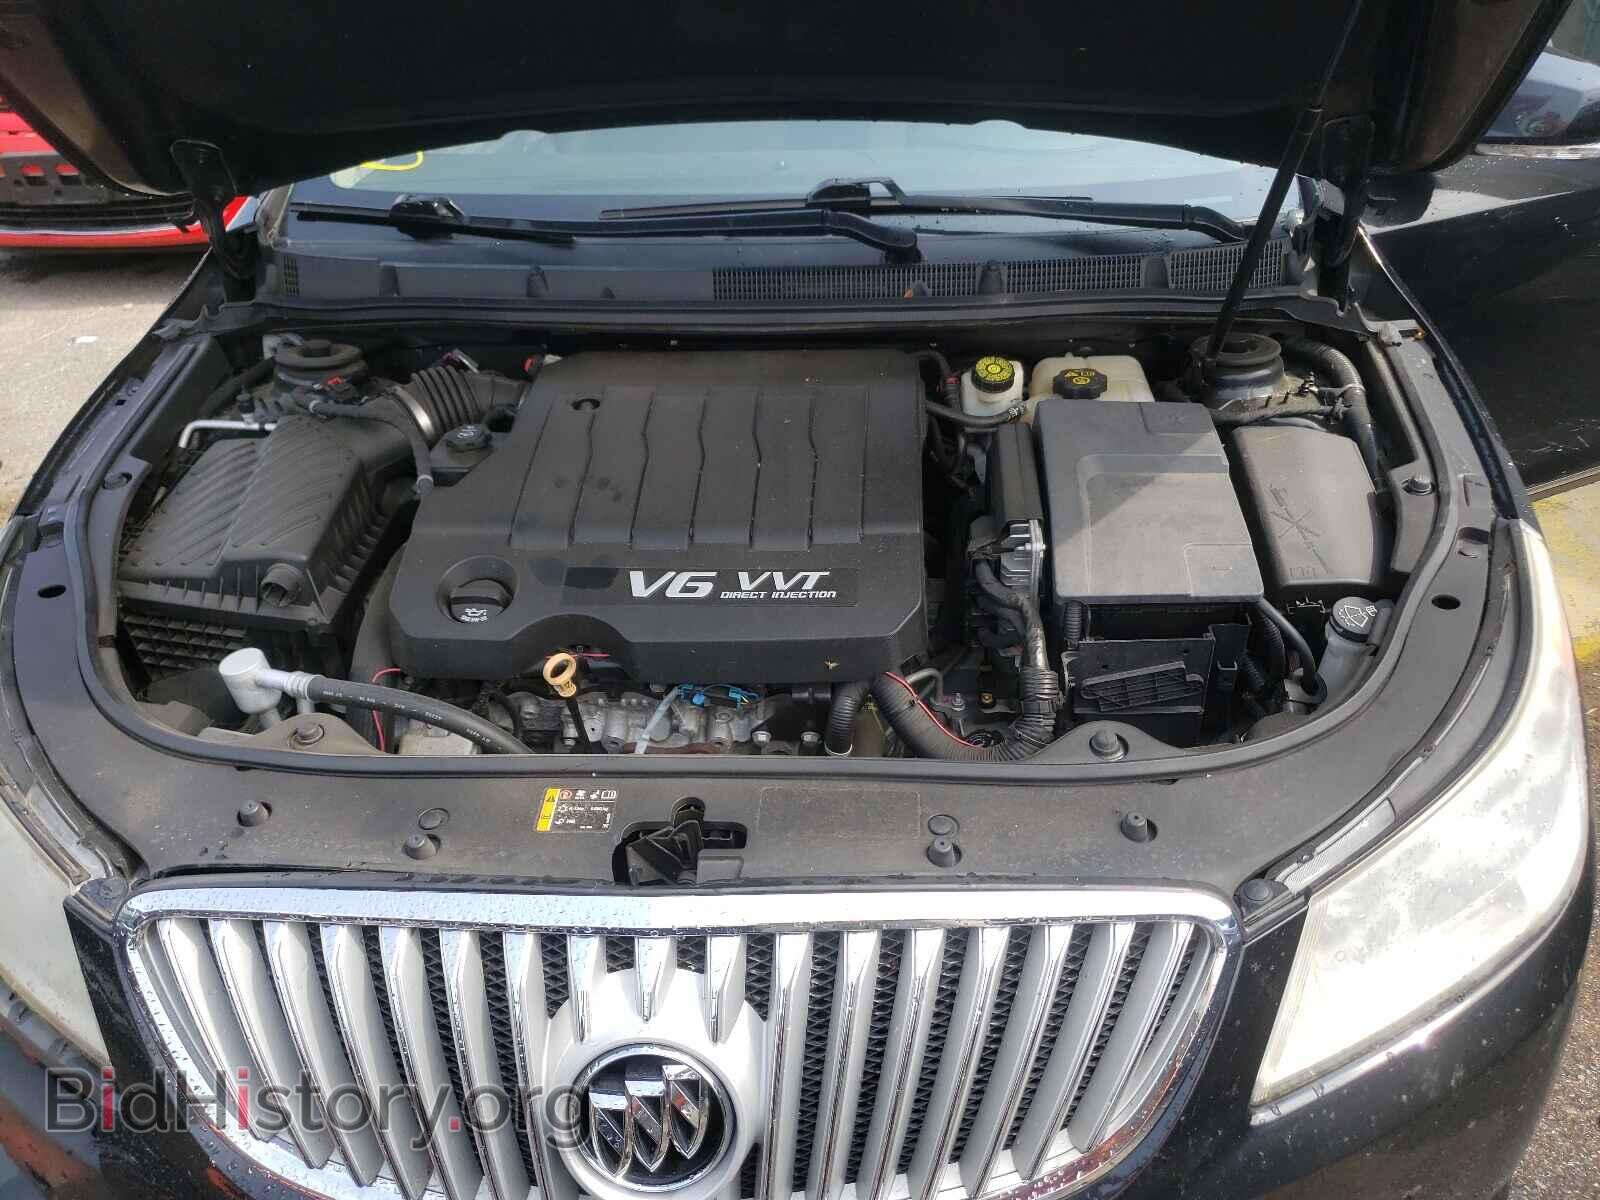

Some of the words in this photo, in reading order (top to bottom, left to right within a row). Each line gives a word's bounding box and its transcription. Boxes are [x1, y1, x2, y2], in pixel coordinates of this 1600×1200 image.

[629, 570, 718, 598] V6
[737, 571, 831, 591] VVT
[720, 591, 768, 599] DIRECT
[771, 591, 837, 599] INJECTION
